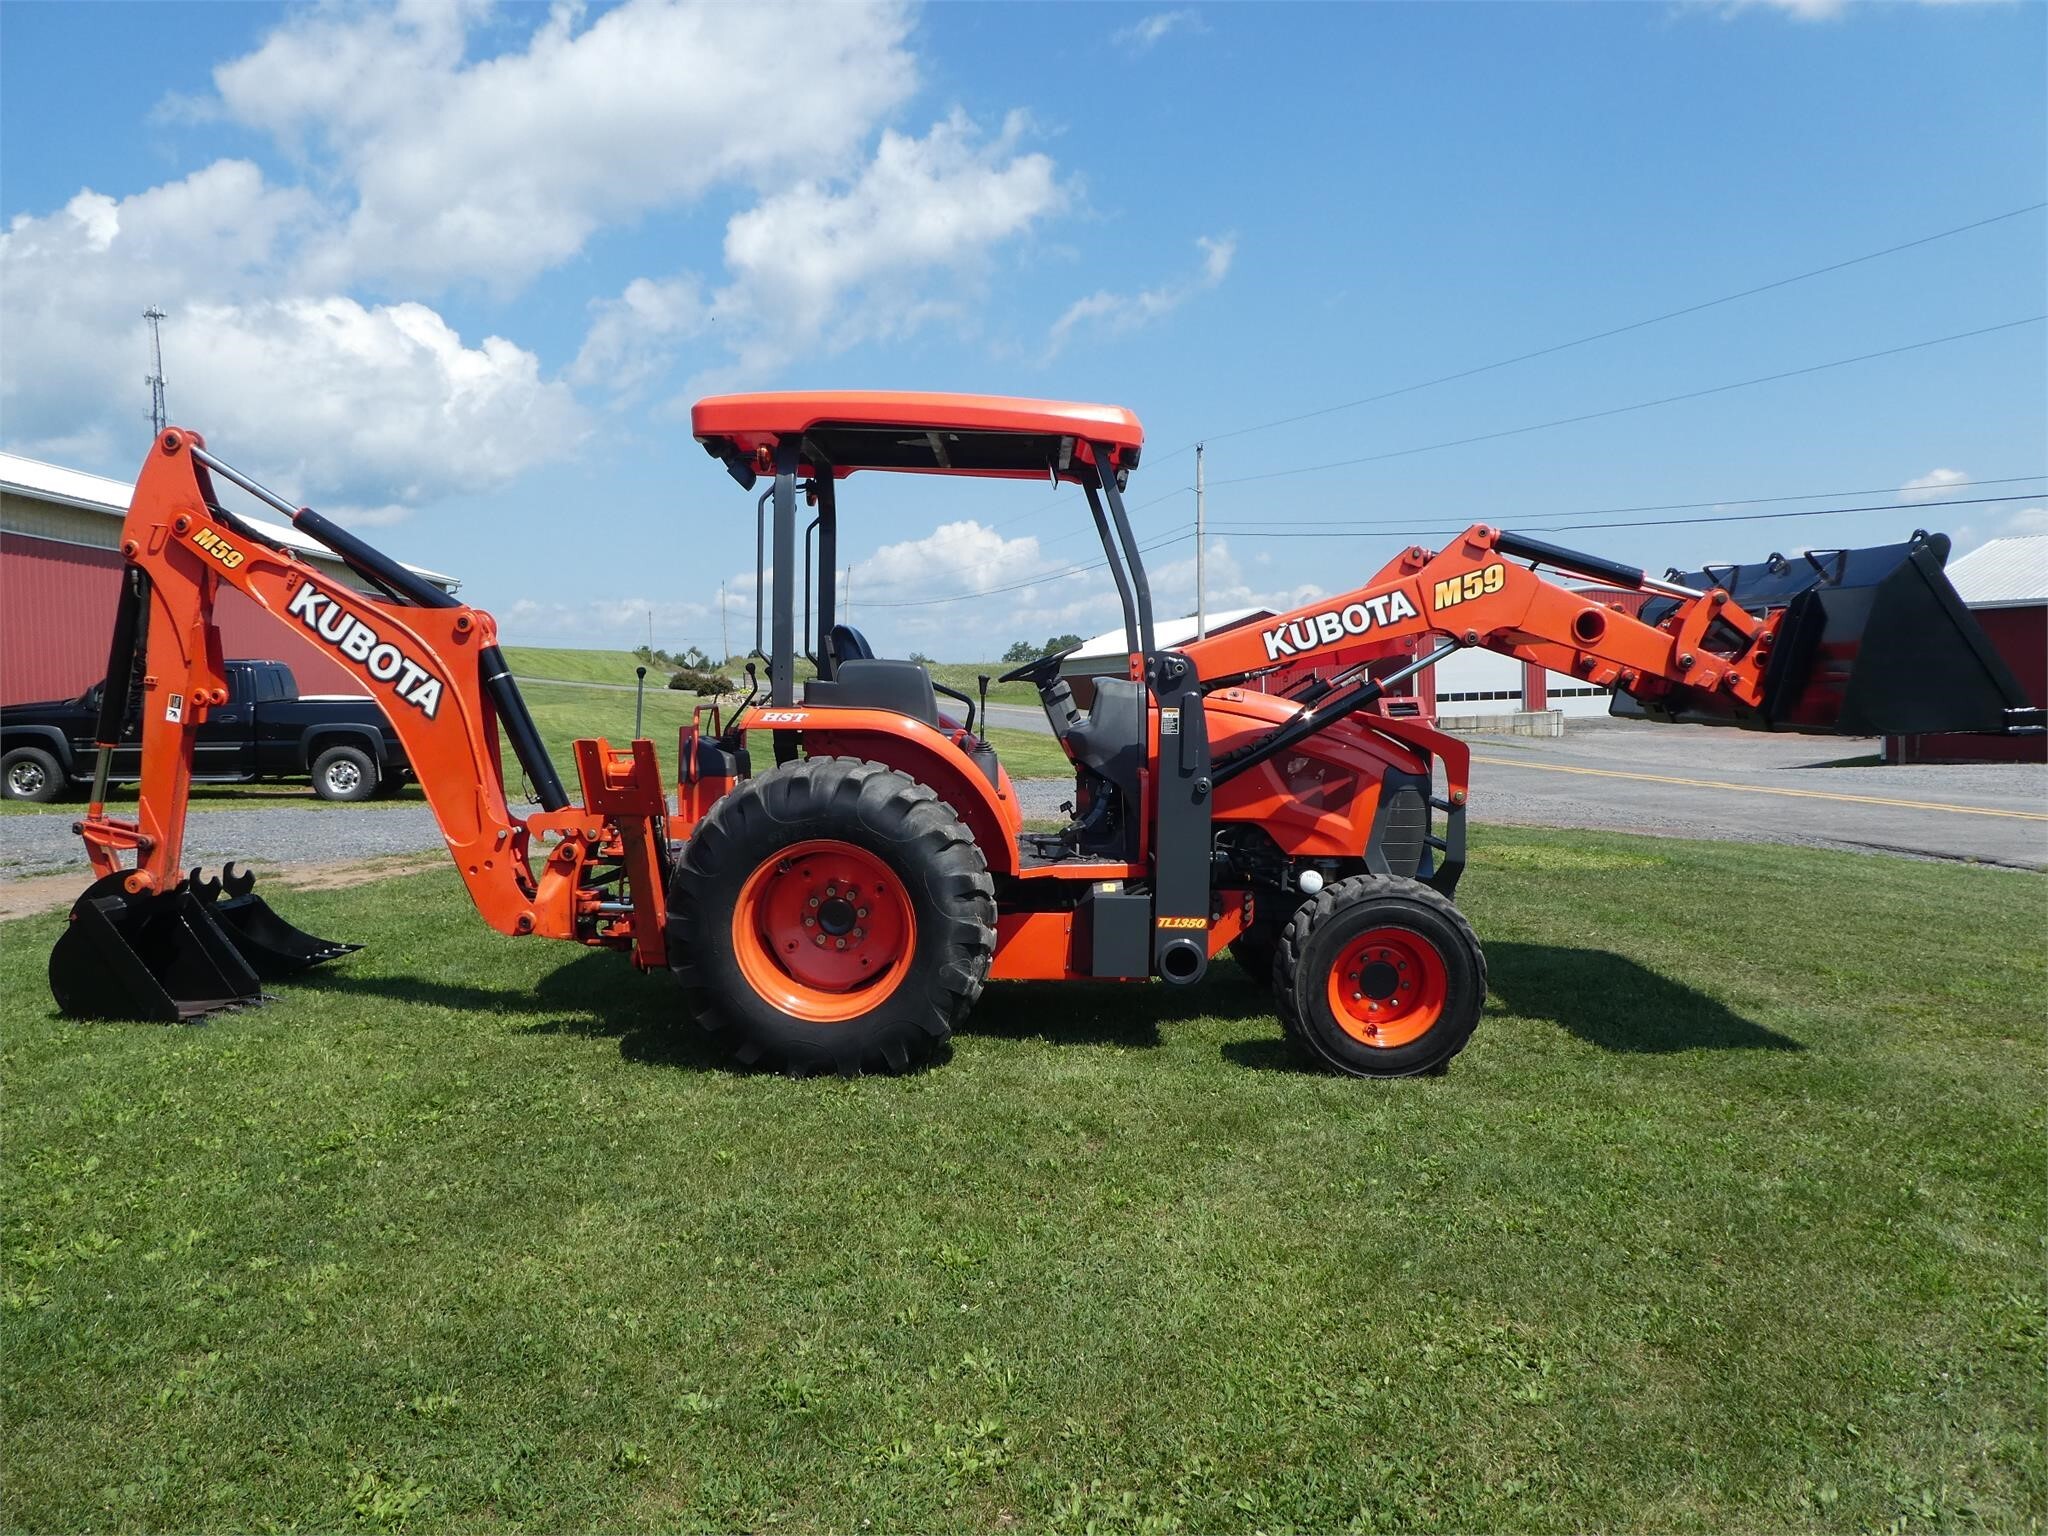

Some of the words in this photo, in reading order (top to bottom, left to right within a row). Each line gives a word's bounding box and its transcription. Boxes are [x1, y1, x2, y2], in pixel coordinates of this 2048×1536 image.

[193, 528, 244, 568] M59
[1434, 564, 1505, 610] M59
[1262, 591, 1418, 660] KUBOTA
[288, 582, 444, 718] KUBOTA
[760, 712, 809, 722] HST
[1158, 917, 1207, 929] TL1350
